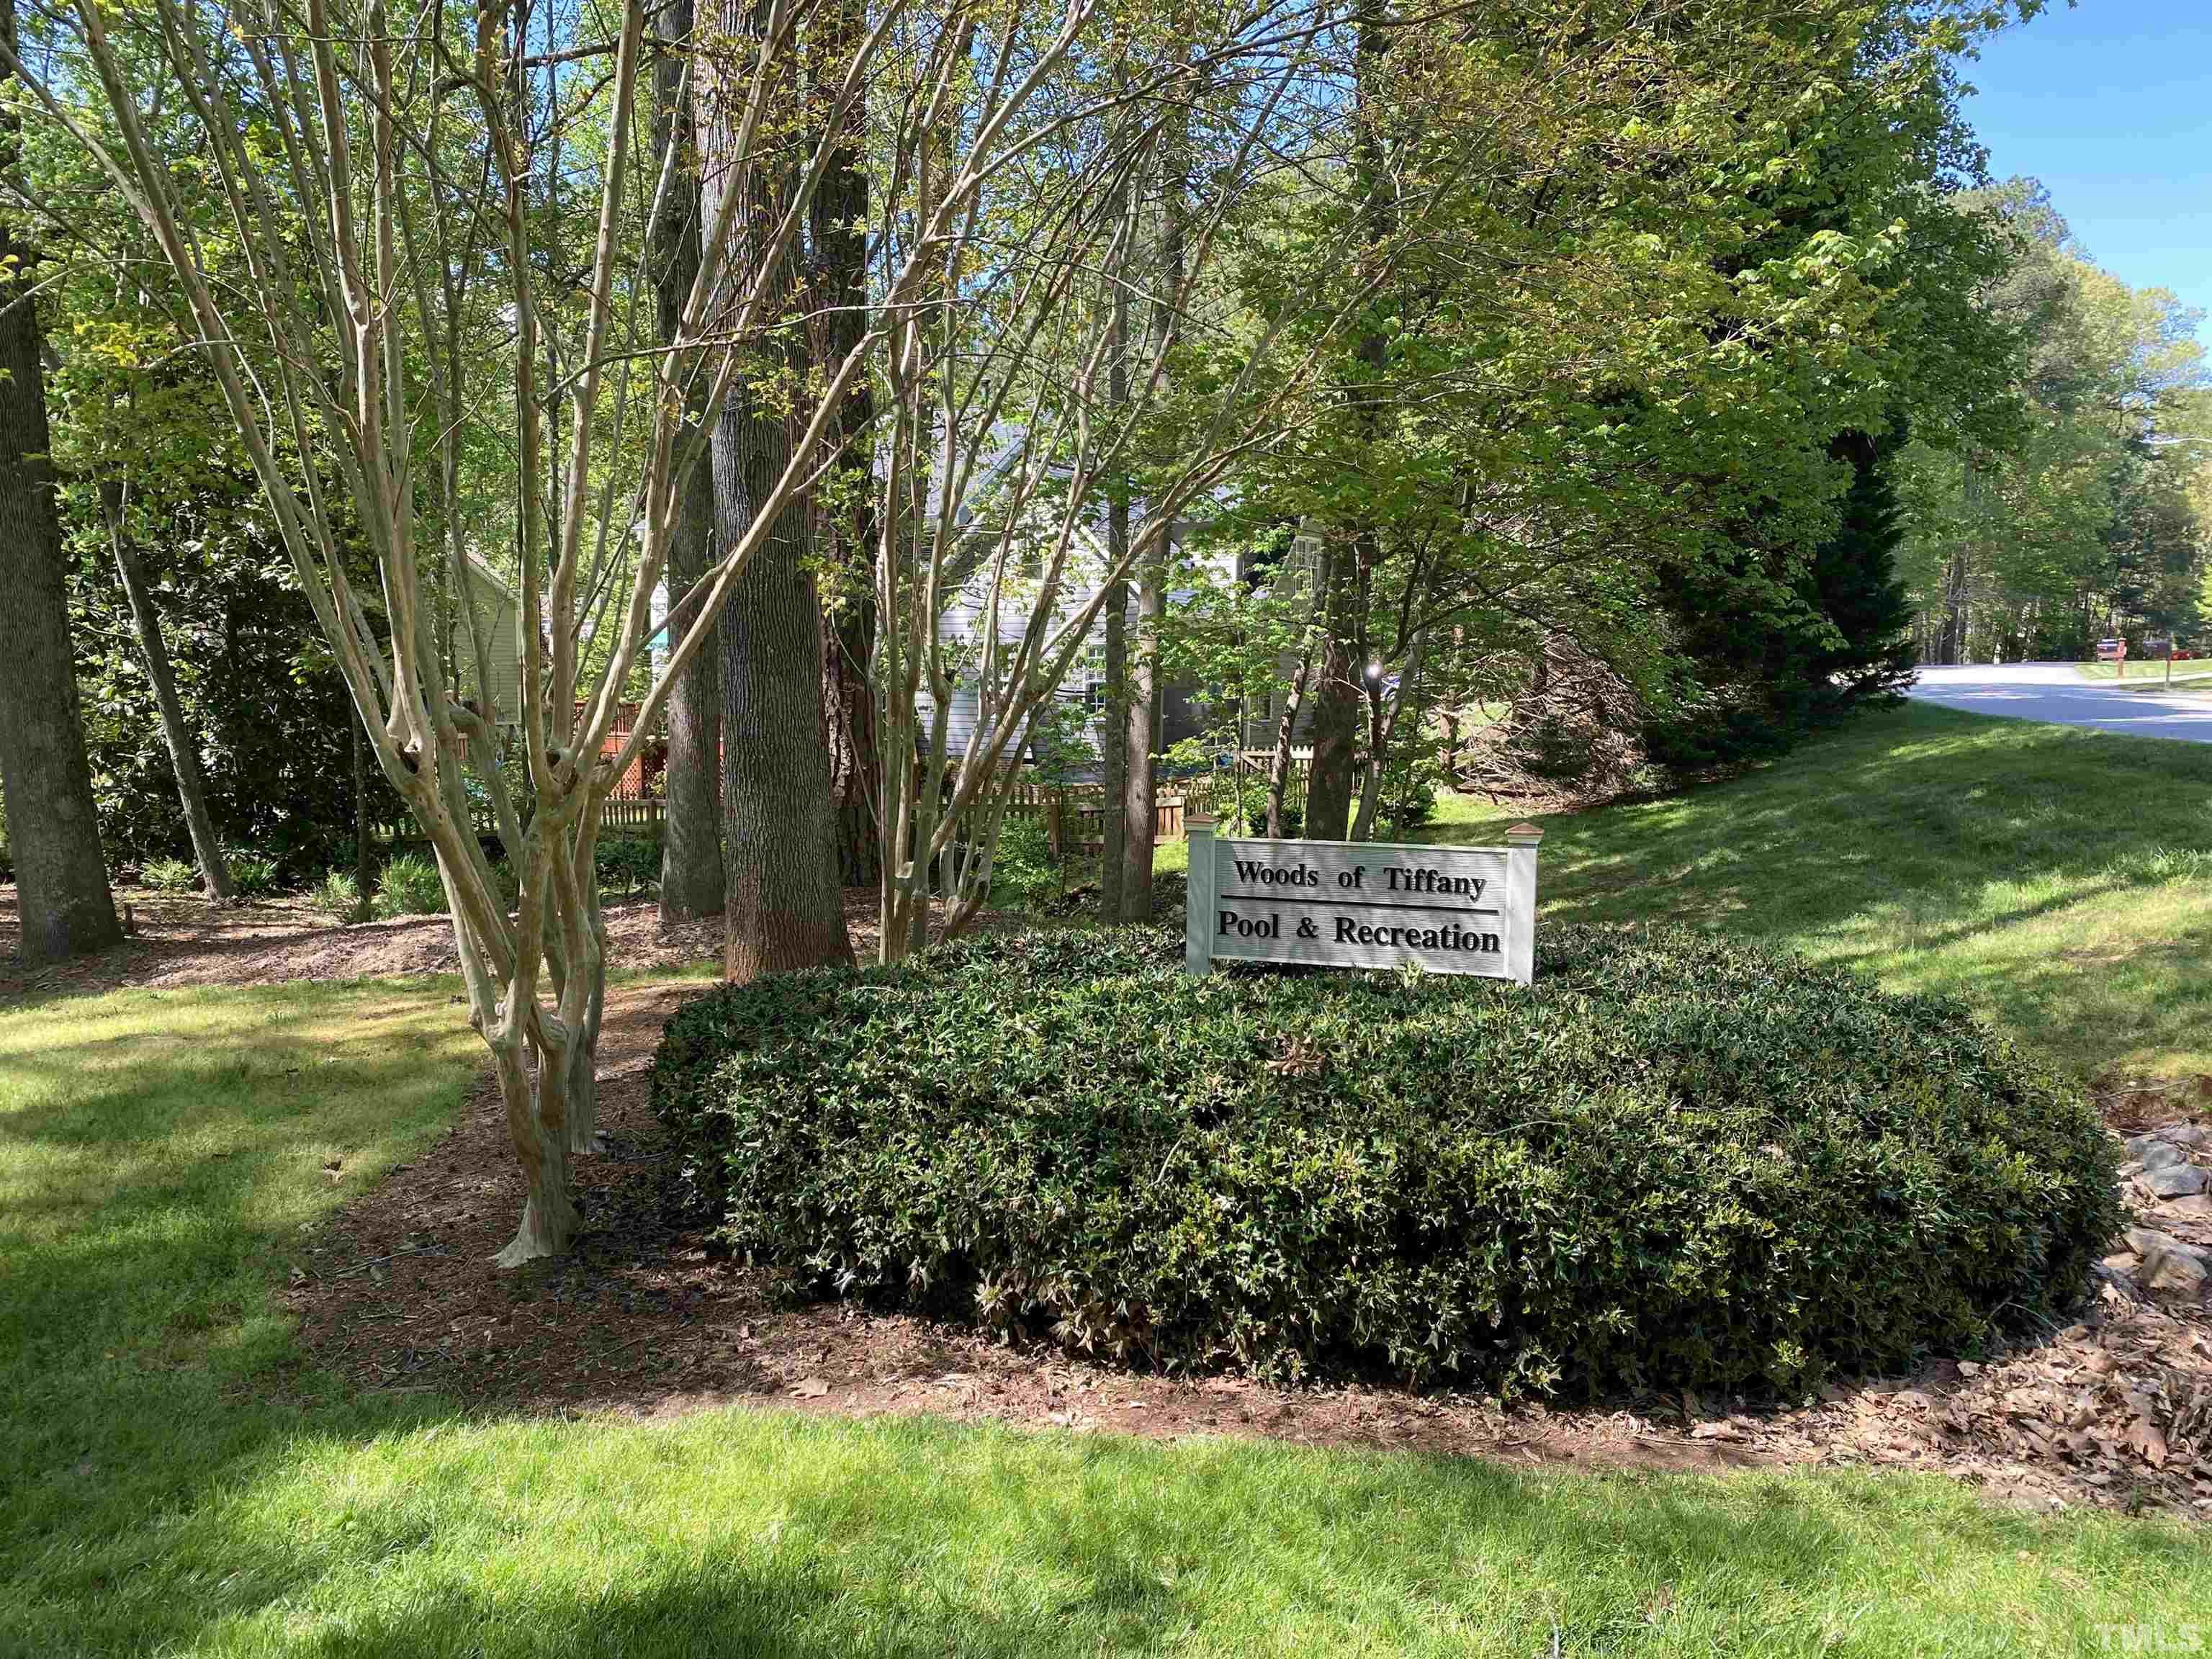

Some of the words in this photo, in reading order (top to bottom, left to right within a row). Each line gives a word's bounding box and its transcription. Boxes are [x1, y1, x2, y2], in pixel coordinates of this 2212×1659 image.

[1235, 860, 1318, 886] Woods
[1339, 866, 1365, 889] of
[1383, 866, 1487, 903] Tiffany
[1218, 910, 1280, 938] Pool
[1296, 916, 1318, 939] &
[1334, 916, 1501, 953] Recreation
